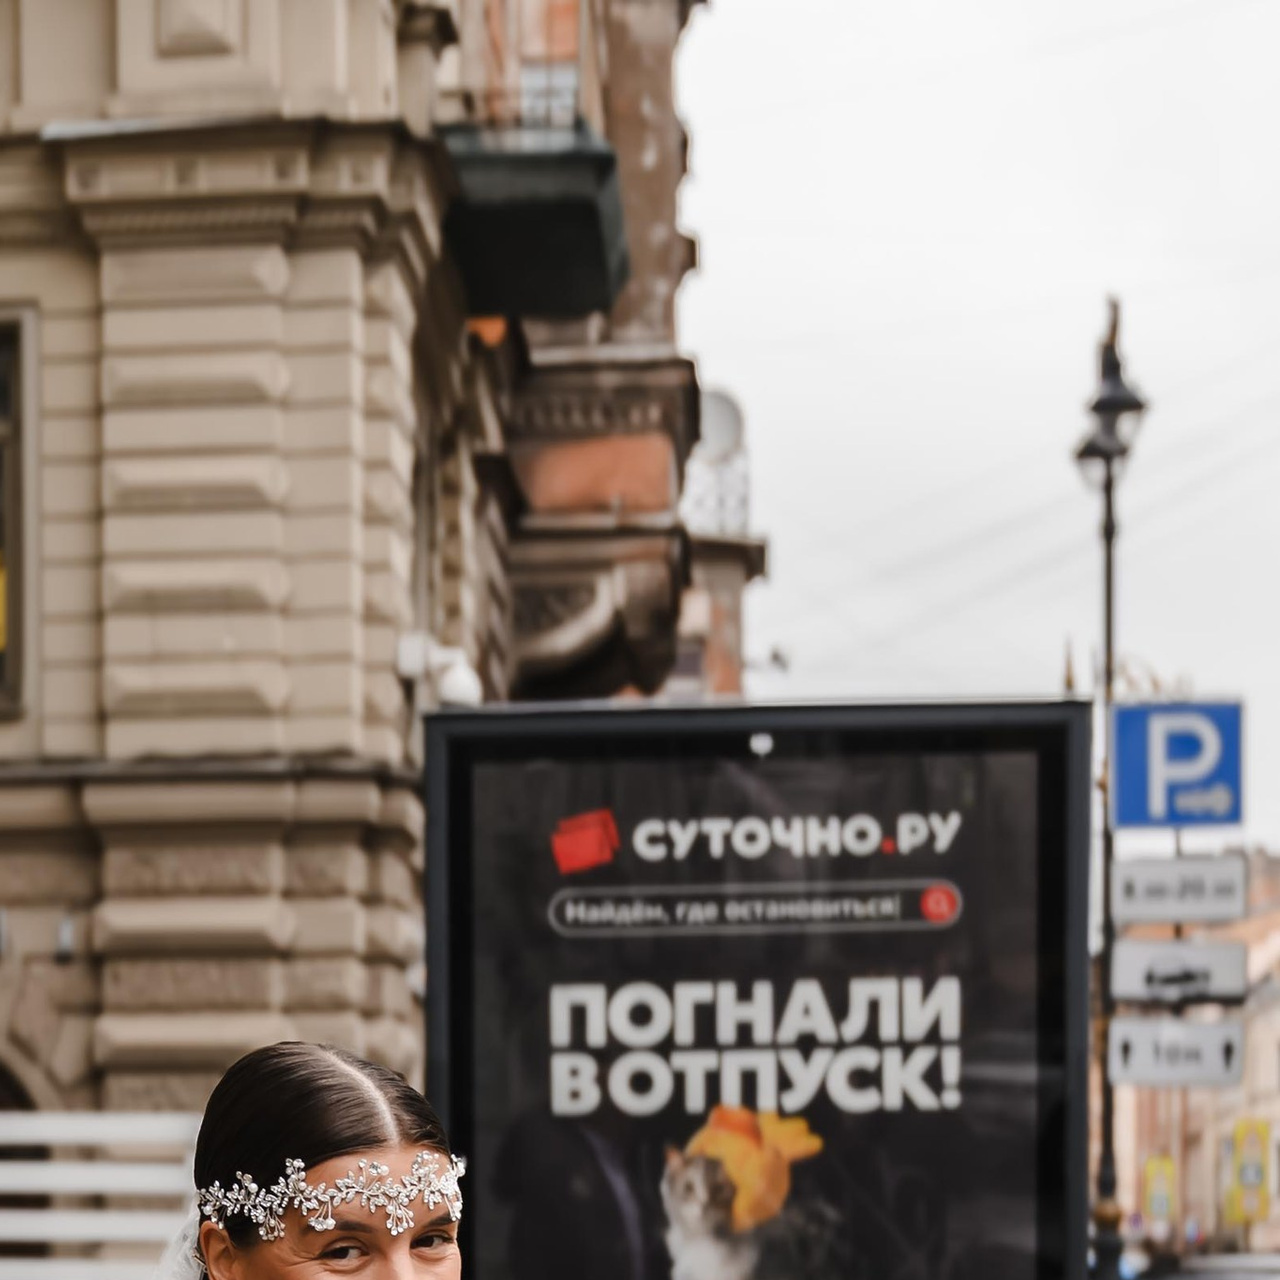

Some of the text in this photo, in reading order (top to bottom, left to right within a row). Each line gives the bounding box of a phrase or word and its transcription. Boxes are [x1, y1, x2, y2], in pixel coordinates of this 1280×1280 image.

[1147, 712, 1222, 820] P
[632, 811, 962, 862] СУТОЧНО.РУ
[675, 900, 719, 925] где
[724, 896, 896, 922] остановиться
[549, 976, 961, 1049] ПОГНАЛИ
